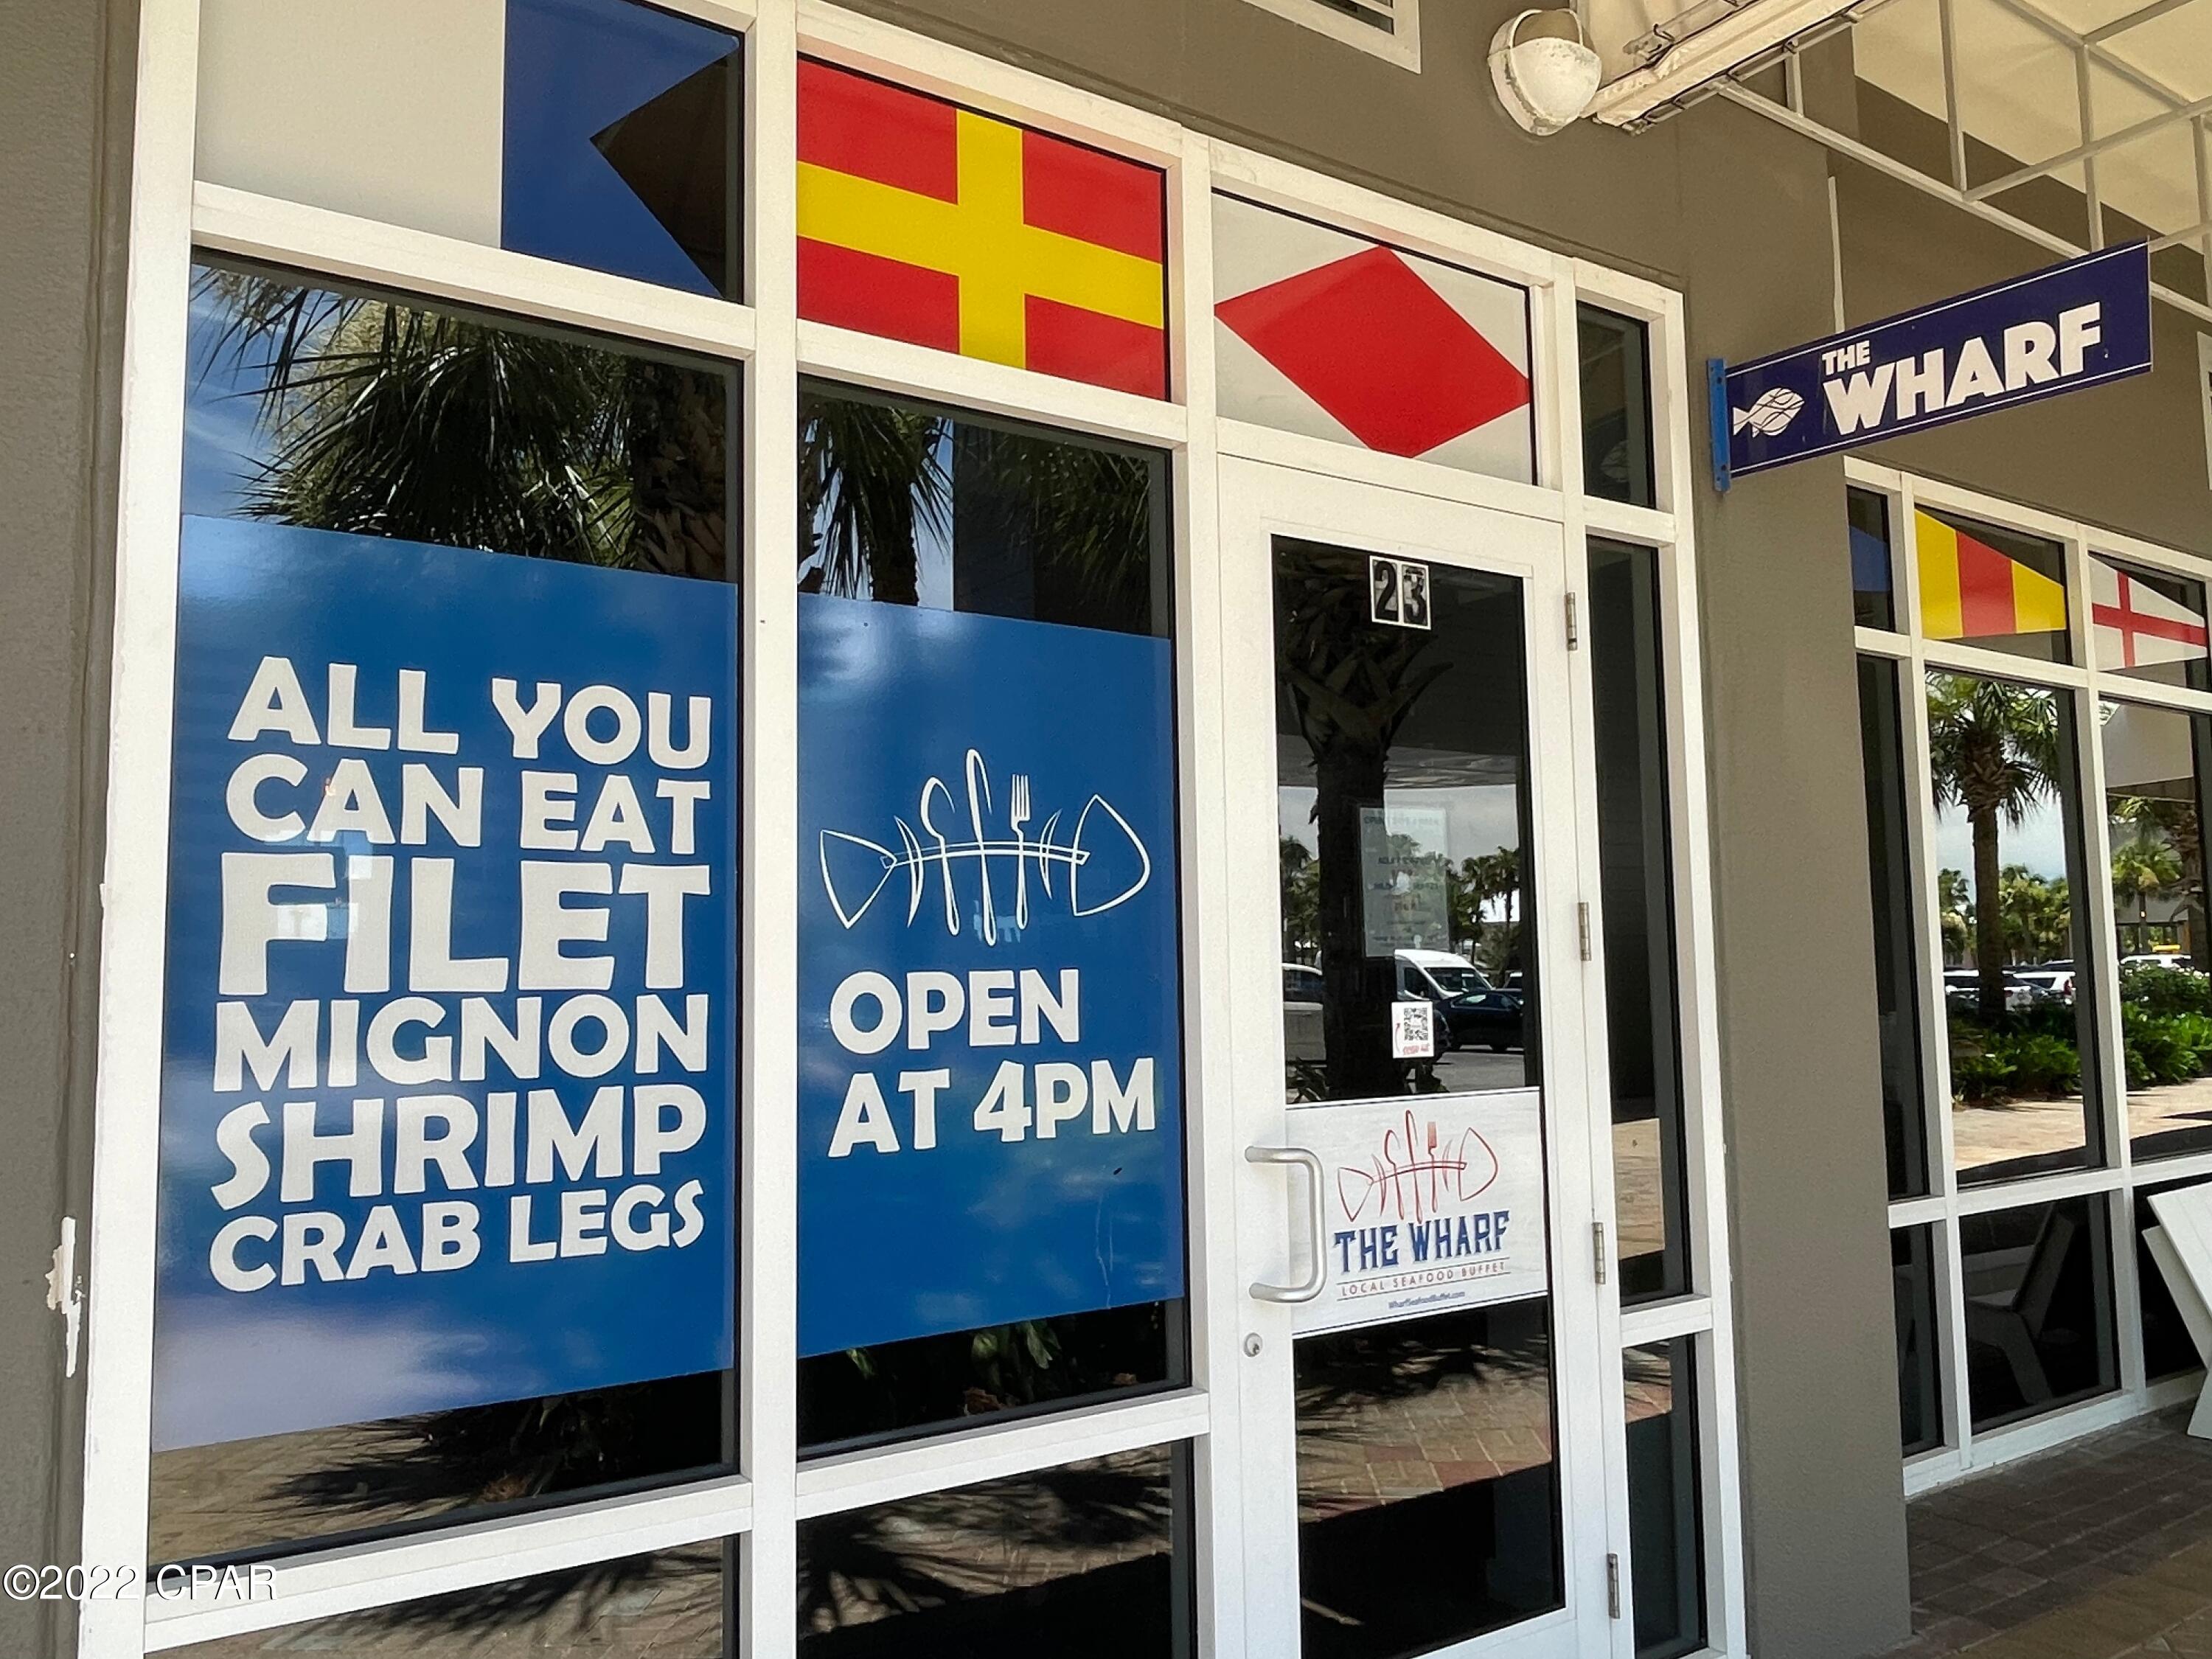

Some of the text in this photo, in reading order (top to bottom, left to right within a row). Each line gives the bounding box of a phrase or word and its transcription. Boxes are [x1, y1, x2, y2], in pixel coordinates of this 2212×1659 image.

[1822, 340, 1871, 375] THE
[1823, 302, 2101, 436] WHARF
[1372, 560, 1428, 626] 23
[227, 655, 712, 769] ALL YOU
[226, 754, 711, 855] CAN EAT
[218, 852, 712, 995] FILET
[214, 993, 709, 1093] MIGNON
[830, 968, 1079, 1054] OPEN
[210, 1084, 707, 1211] SHRIMP
[827, 1057, 1156, 1158] AT 4PM
[209, 1179, 705, 1293] CRAB LEGS
[1334, 1209, 1510, 1273] THE WHARF
[1341, 1261, 1506, 1297] LOCAL SEAFOOD BUFFET
